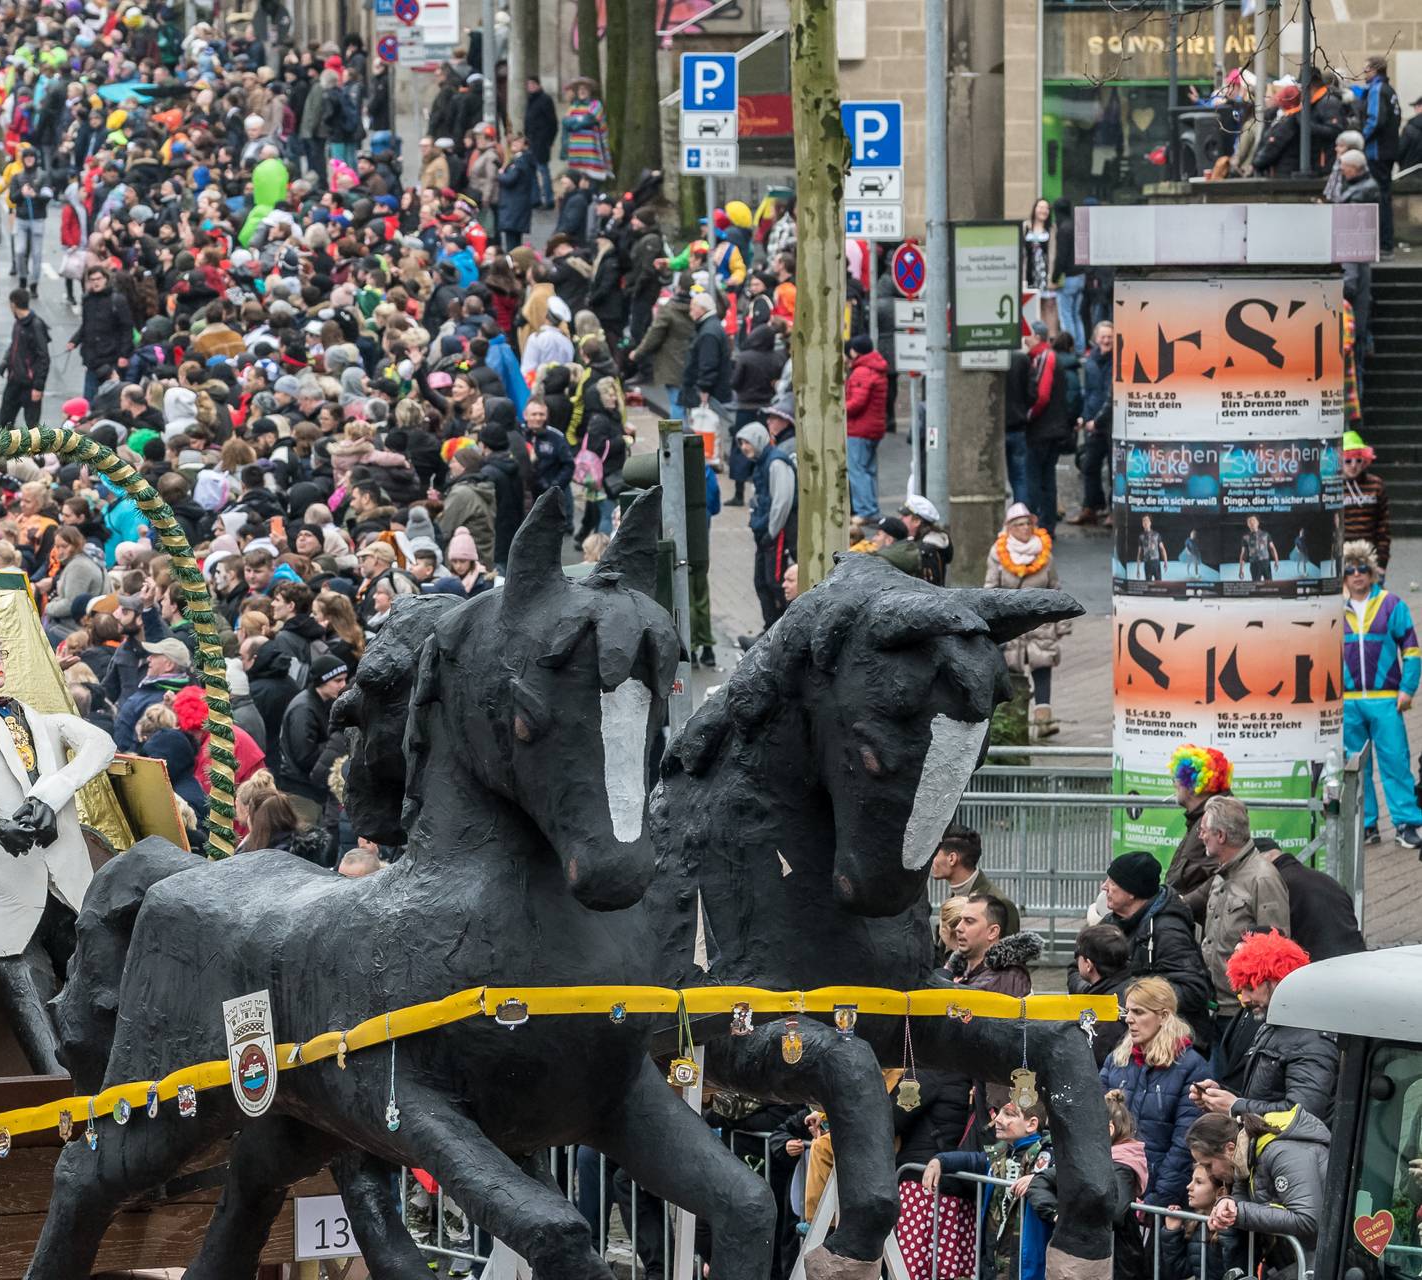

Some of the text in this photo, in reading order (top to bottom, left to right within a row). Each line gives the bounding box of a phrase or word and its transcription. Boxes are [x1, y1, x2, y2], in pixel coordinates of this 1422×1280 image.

[695, 61, 724, 105] P
[855, 110, 888, 160] P
[1144, 400, 1156, 408] ist
[1159, 400, 1182, 408] dein
[1222, 400, 1240, 408] Ein
[1285, 399, 1309, 407] nach
[1128, 410, 1159, 418] Drama?
[1222, 408, 1301, 417] dem anderen.
[1158, 496, 1169, 504] ich
[1170, 497, 1195, 505] sicher
[1223, 496, 1250, 506] Dinge,
[1252, 496, 1265, 504] die
[1267, 496, 1279, 504] ich
[1281, 496, 1303, 504] sicher
[1137, 719, 1167, 728] Drama
[1169, 720, 1197, 729] nach
[1241, 721, 1267, 729] weit
[1270, 721, 1302, 729] reicht
[1142, 729, 1186, 737] anderen.
[1239, 729, 1277, 738] Stück?
[1264, 780, 1282, 788] 2020
[1146, 826, 1167, 836] LISZT
[315, 1218, 350, 1250] 13
